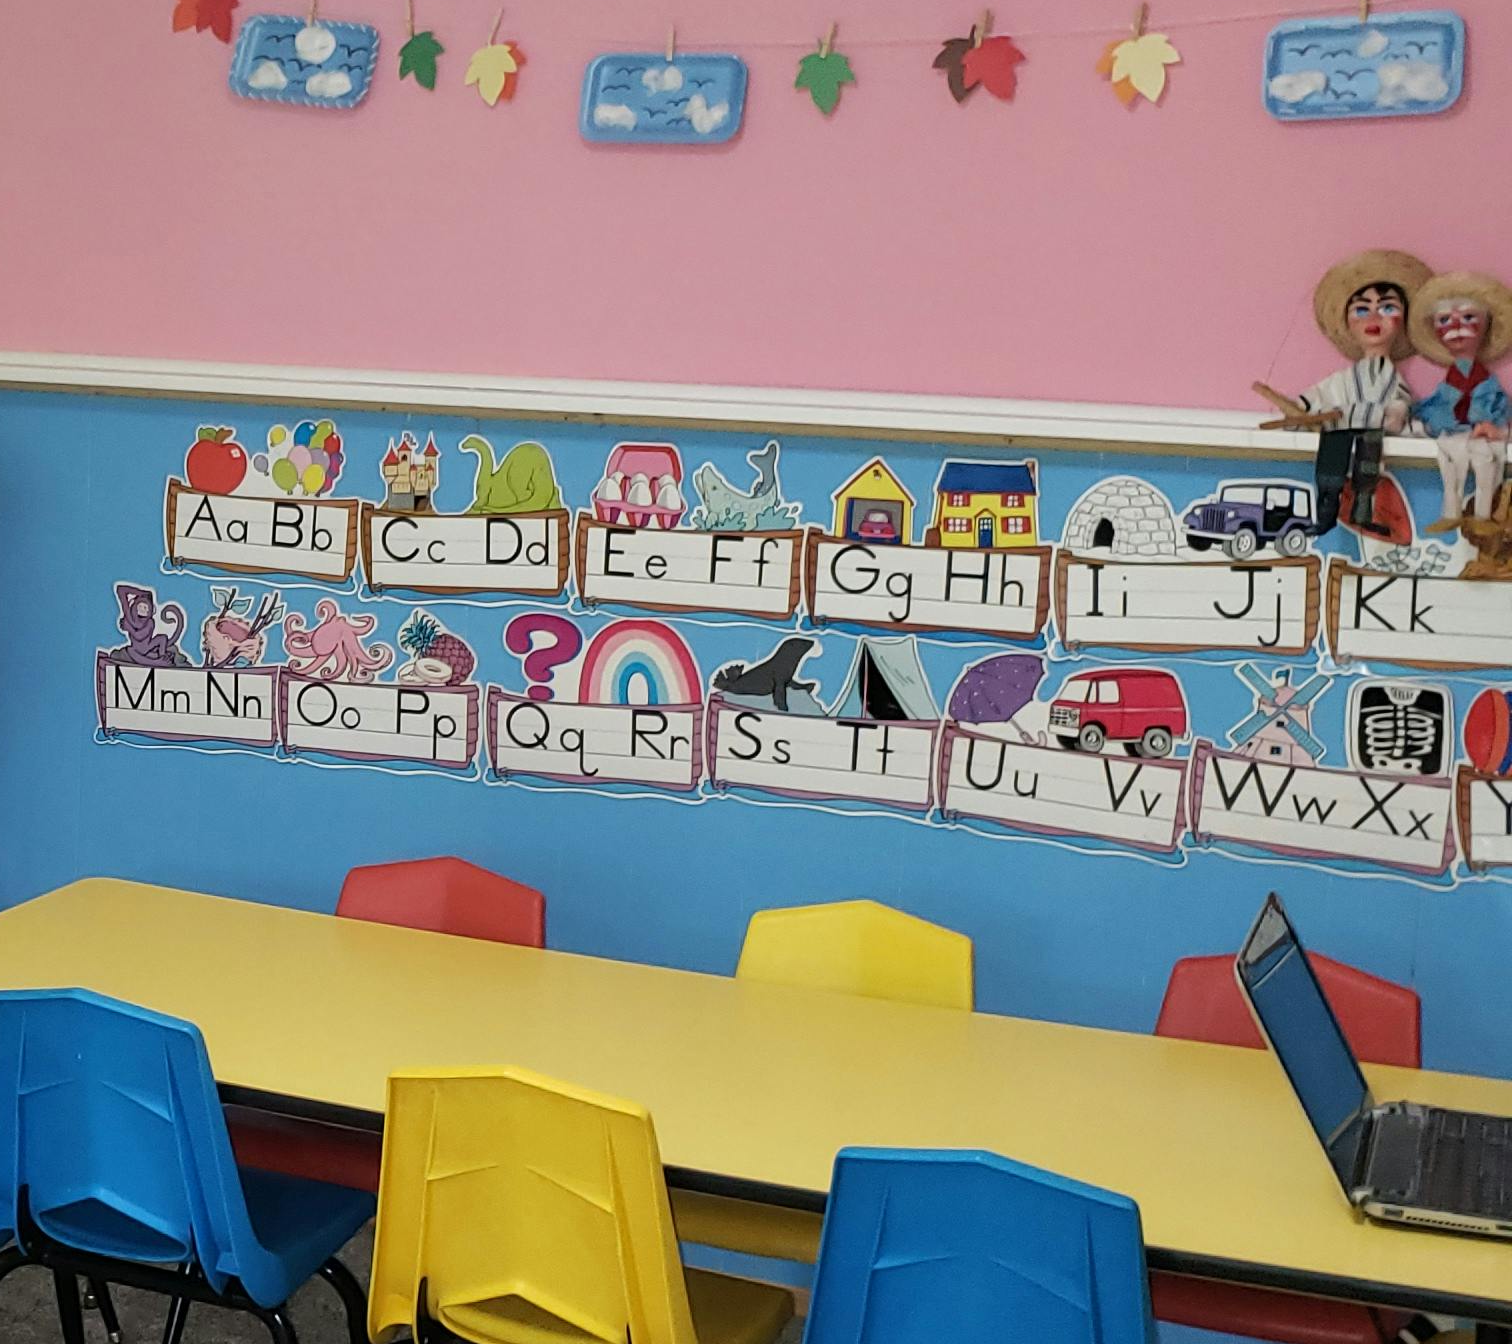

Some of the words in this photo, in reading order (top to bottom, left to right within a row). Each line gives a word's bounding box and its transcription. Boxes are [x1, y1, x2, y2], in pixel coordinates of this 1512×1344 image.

[185, 496, 247, 545] Aa
[272, 504, 333, 553] Bb
[381, 518, 446, 565] Cc
[486, 518, 550, 567] Dd
[603, 529, 667, 579] Ee
[710, 535, 779, 587] Ff
[830, 545, 912, 621] Gg
[944, 551, 1023, 606] Hh
[1355, 576, 1435, 634] Kk
[114, 667, 190, 714] Mm
[206, 672, 262, 718] Nn
[297, 684, 361, 729] Oo
[396, 691, 457, 758] Pp
[505, 702, 599, 776] Qq
[631, 712, 689, 759] Rr
[729, 712, 791, 764] Ss
[836, 721, 894, 775] Tt
[965, 742, 1038, 799] Uu
[1103, 761, 1162, 817] Vv
[1212, 758, 1337, 823] Ww
[1351, 776, 1434, 842] Xx
